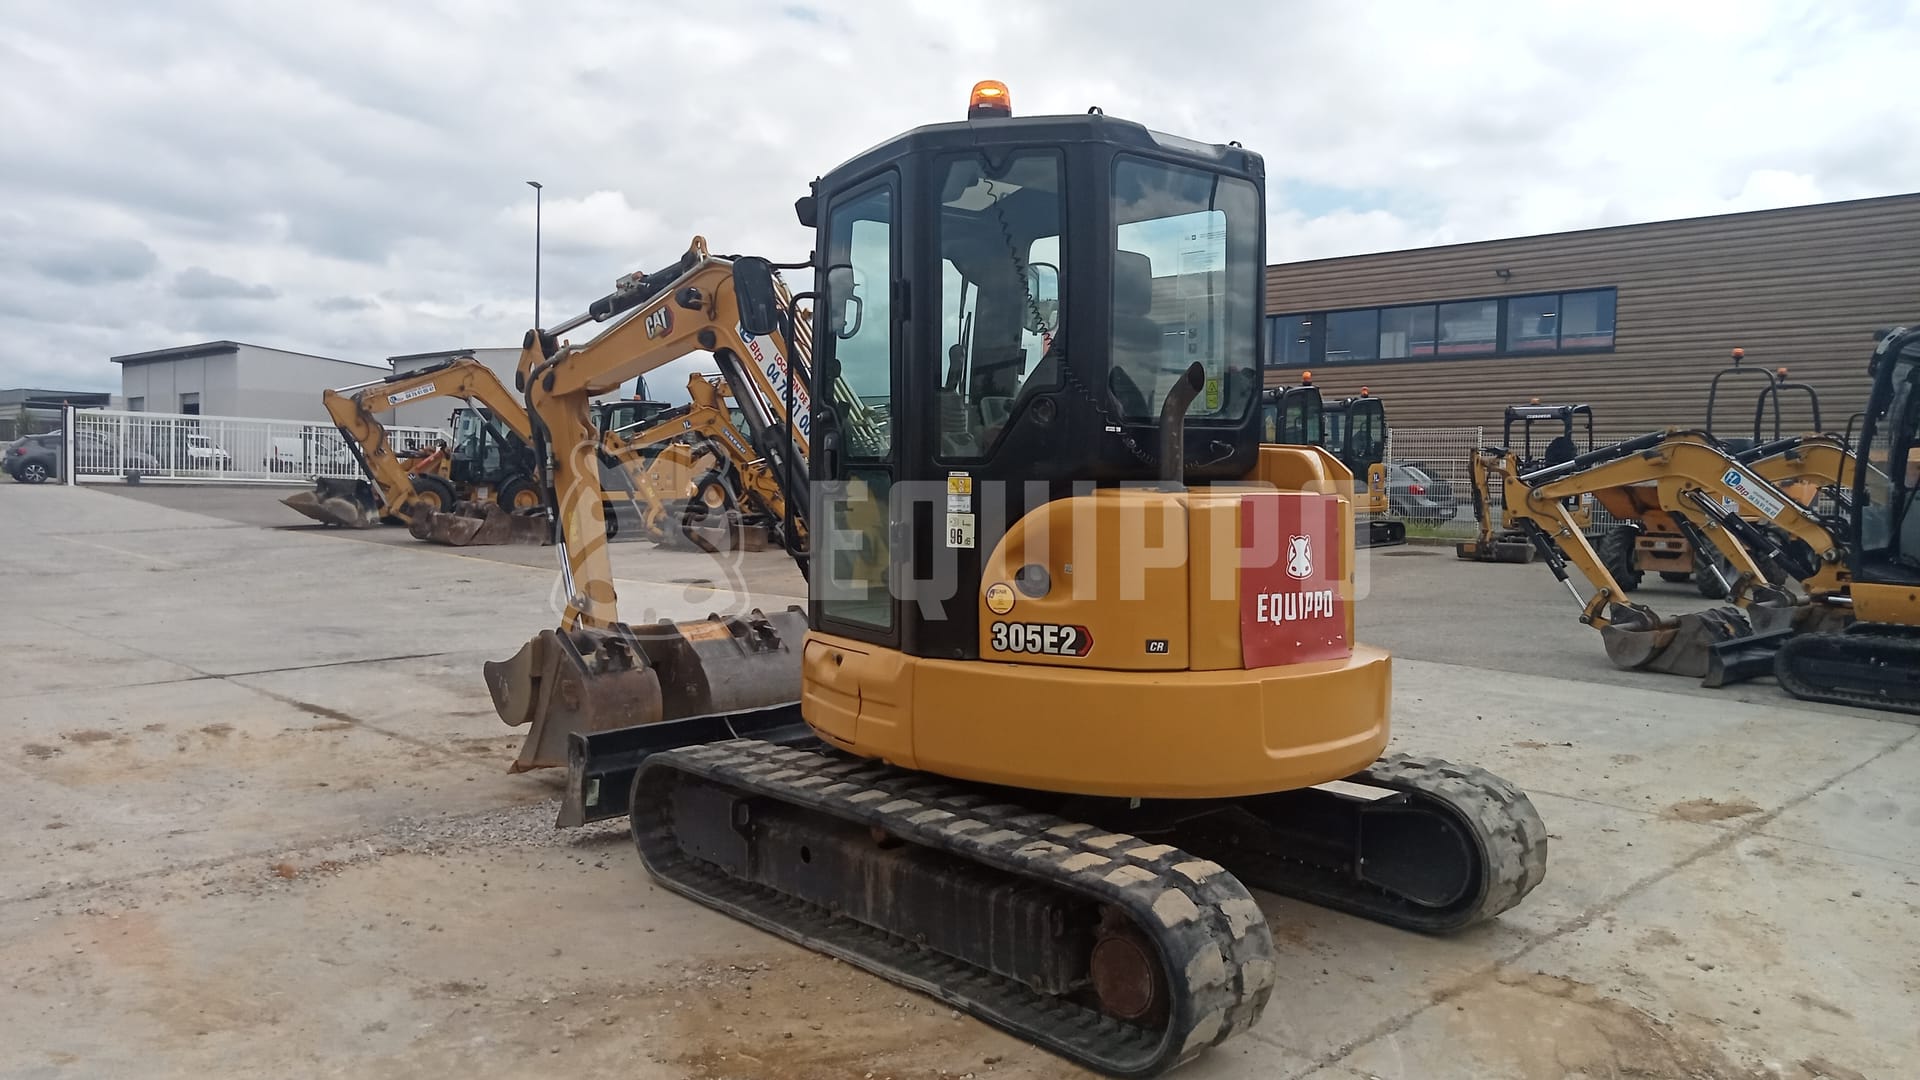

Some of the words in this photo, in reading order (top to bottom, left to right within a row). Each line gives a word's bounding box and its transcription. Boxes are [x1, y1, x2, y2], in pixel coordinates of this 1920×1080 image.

[645, 306, 667, 339] CAT
[749, 340, 764, 362] Btp
[766, 363, 780, 384] 04
[774, 353, 799, 393] LOCAON
[1735, 484, 1750, 496] Btp
[950, 528, 963, 544] 96
[992, 622, 1077, 655] 305E2
[1149, 641, 1164, 652] CR
